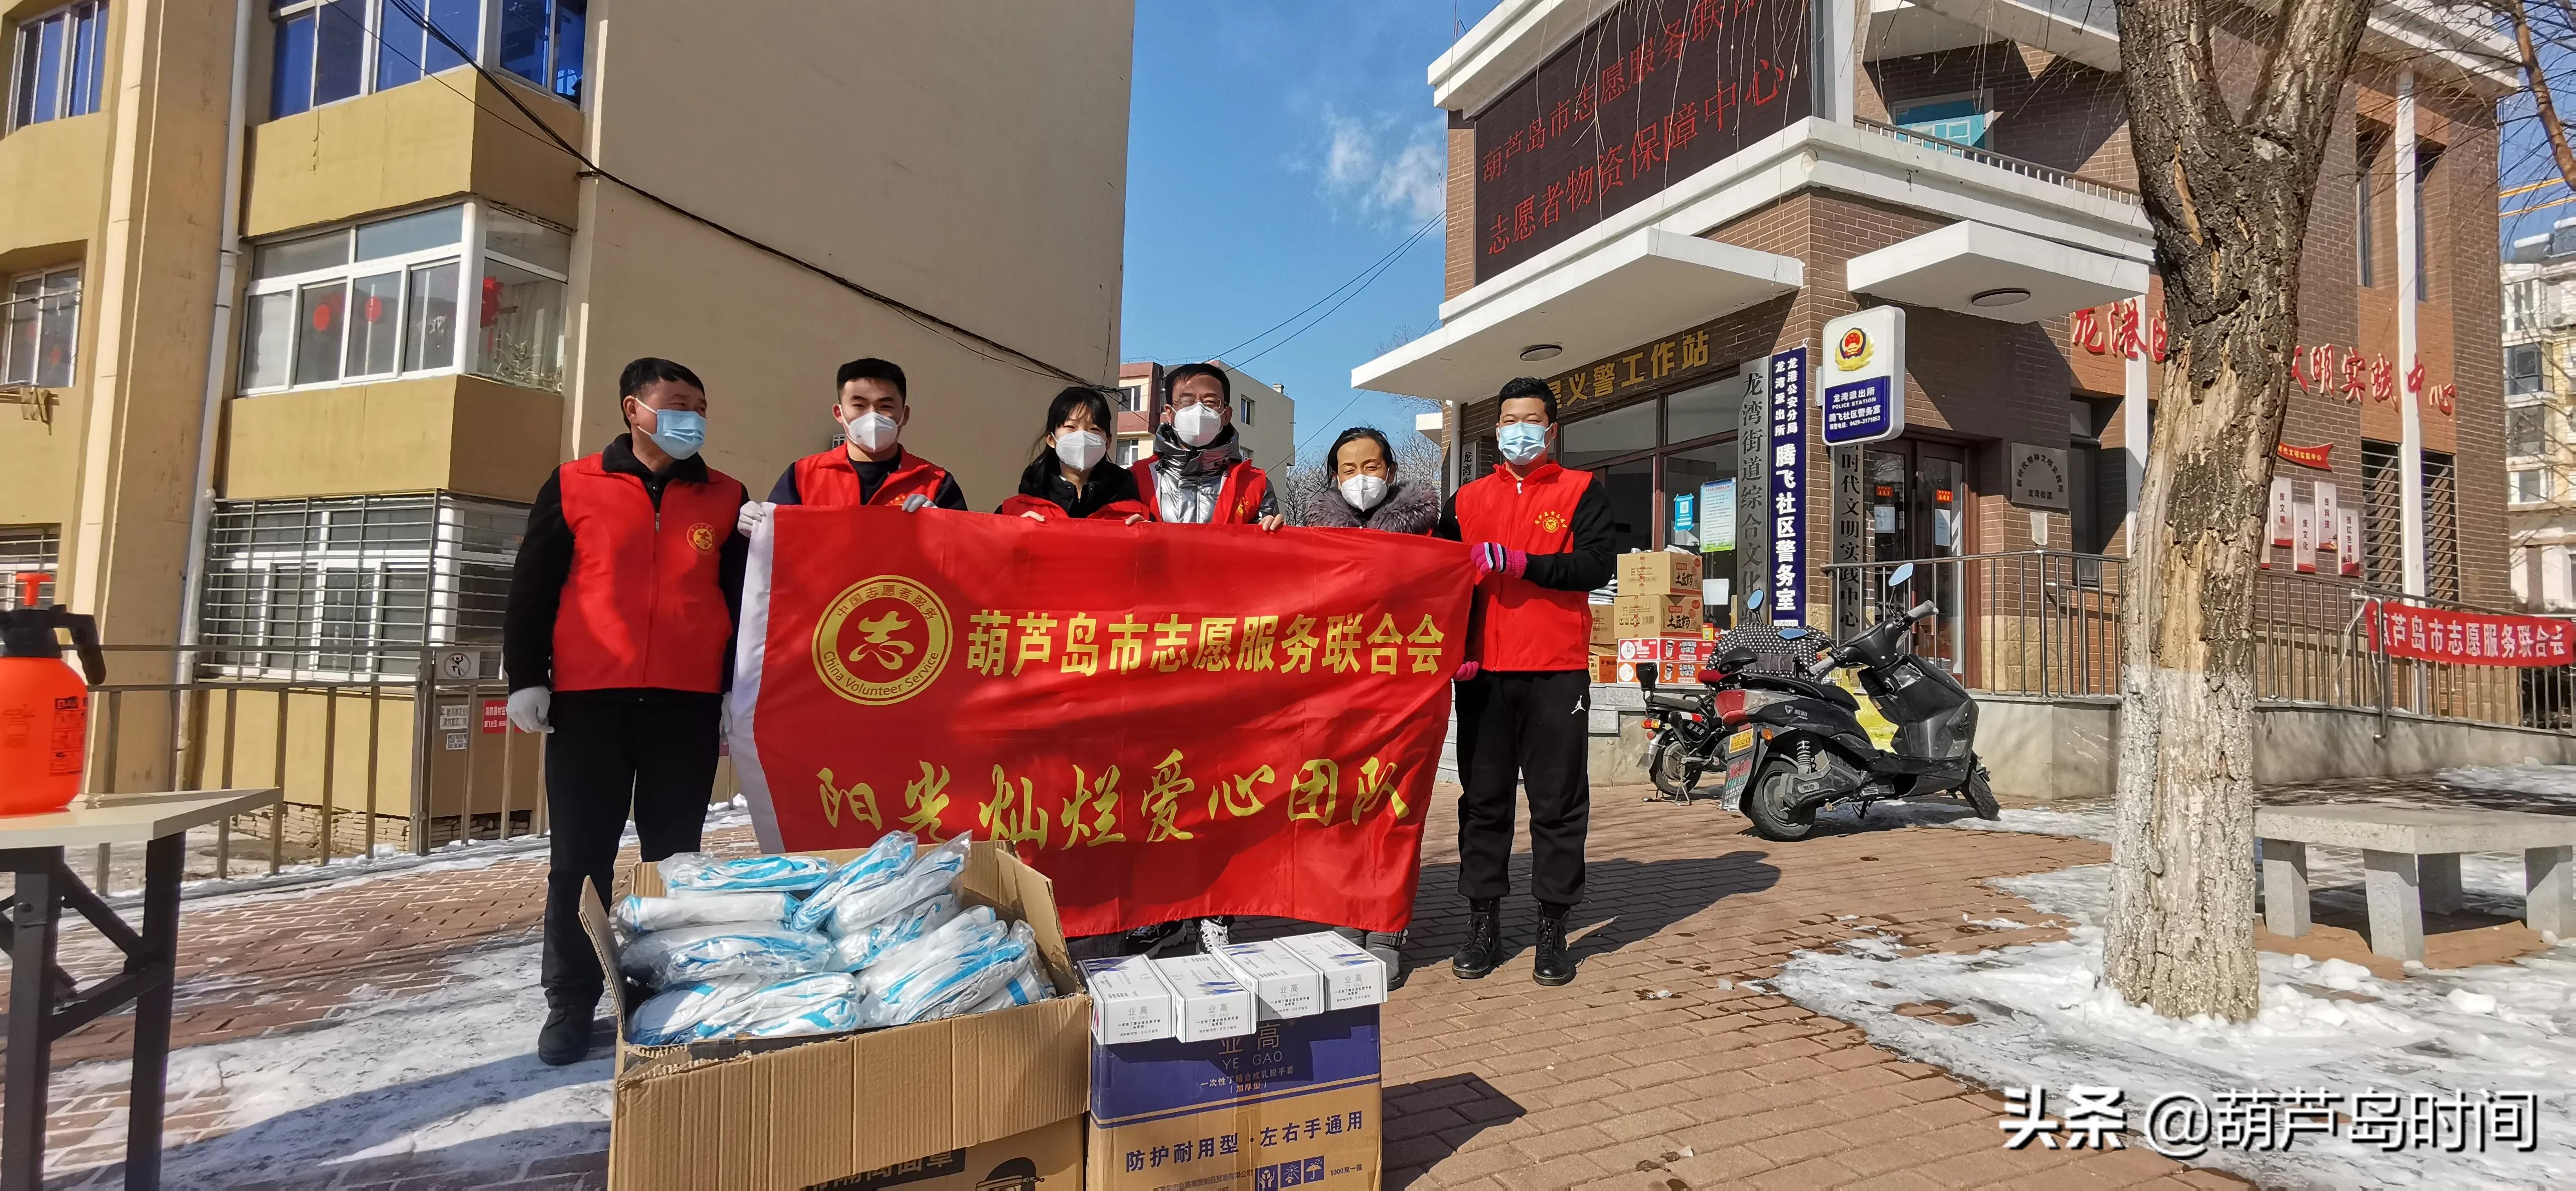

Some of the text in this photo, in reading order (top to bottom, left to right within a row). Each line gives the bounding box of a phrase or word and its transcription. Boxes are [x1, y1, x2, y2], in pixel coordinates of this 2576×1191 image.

[1482, 0, 1754, 183] 葫芦岛市志愿服务联
[1489, 59, 1785, 254] 志愿者物资保障中心
[1775, 361, 1786, 436] 龙湾派出所
[1787, 358, 1798, 434] 龙港公安分局
[1829, 405, 1881, 422] 腾飞社区警务室
[1833, 387, 1875, 403] 龙湾派出所
[1852, 397, 1876, 406] STATION
[1776, 445, 1797, 611] 腾飞社区警务室
[1839, 445, 1861, 628] 时代文明实践中心
[837, 584, 937, 620] 中国志愿者服务
[824, 651, 939, 696] China Volunteer Service
[967, 610, 1444, 677] 葫芦岛市志愿服务联合会
[816, 749, 1409, 850] 阳光灿烂爱心团队
[1223, 1051, 1282, 1070] YE GAO
